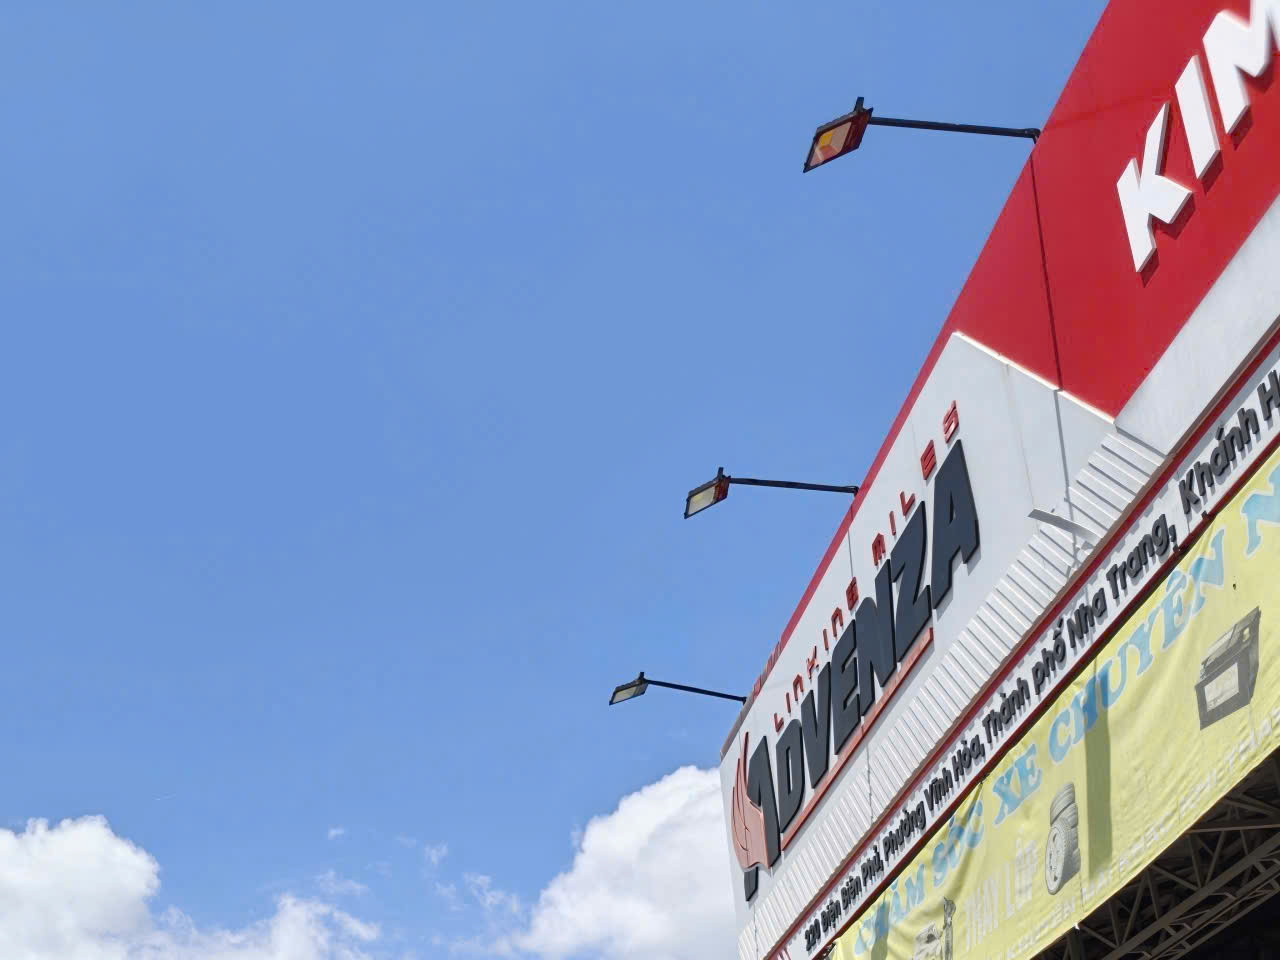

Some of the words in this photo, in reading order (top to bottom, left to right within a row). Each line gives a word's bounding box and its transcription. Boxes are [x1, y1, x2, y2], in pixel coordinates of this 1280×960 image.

[924, 768, 953, 812] Vĩnh
[982, 677, 1030, 744] Thành
[1031, 617, 1067, 696] phố
[1066, 588, 1108, 649] Nha
[1105, 513, 1178, 600] Trang,
[1178, 408, 1260, 515] Khánh
[991, 744, 1042, 826] XE
[1047, 526, 1226, 764] CHUYÊN
